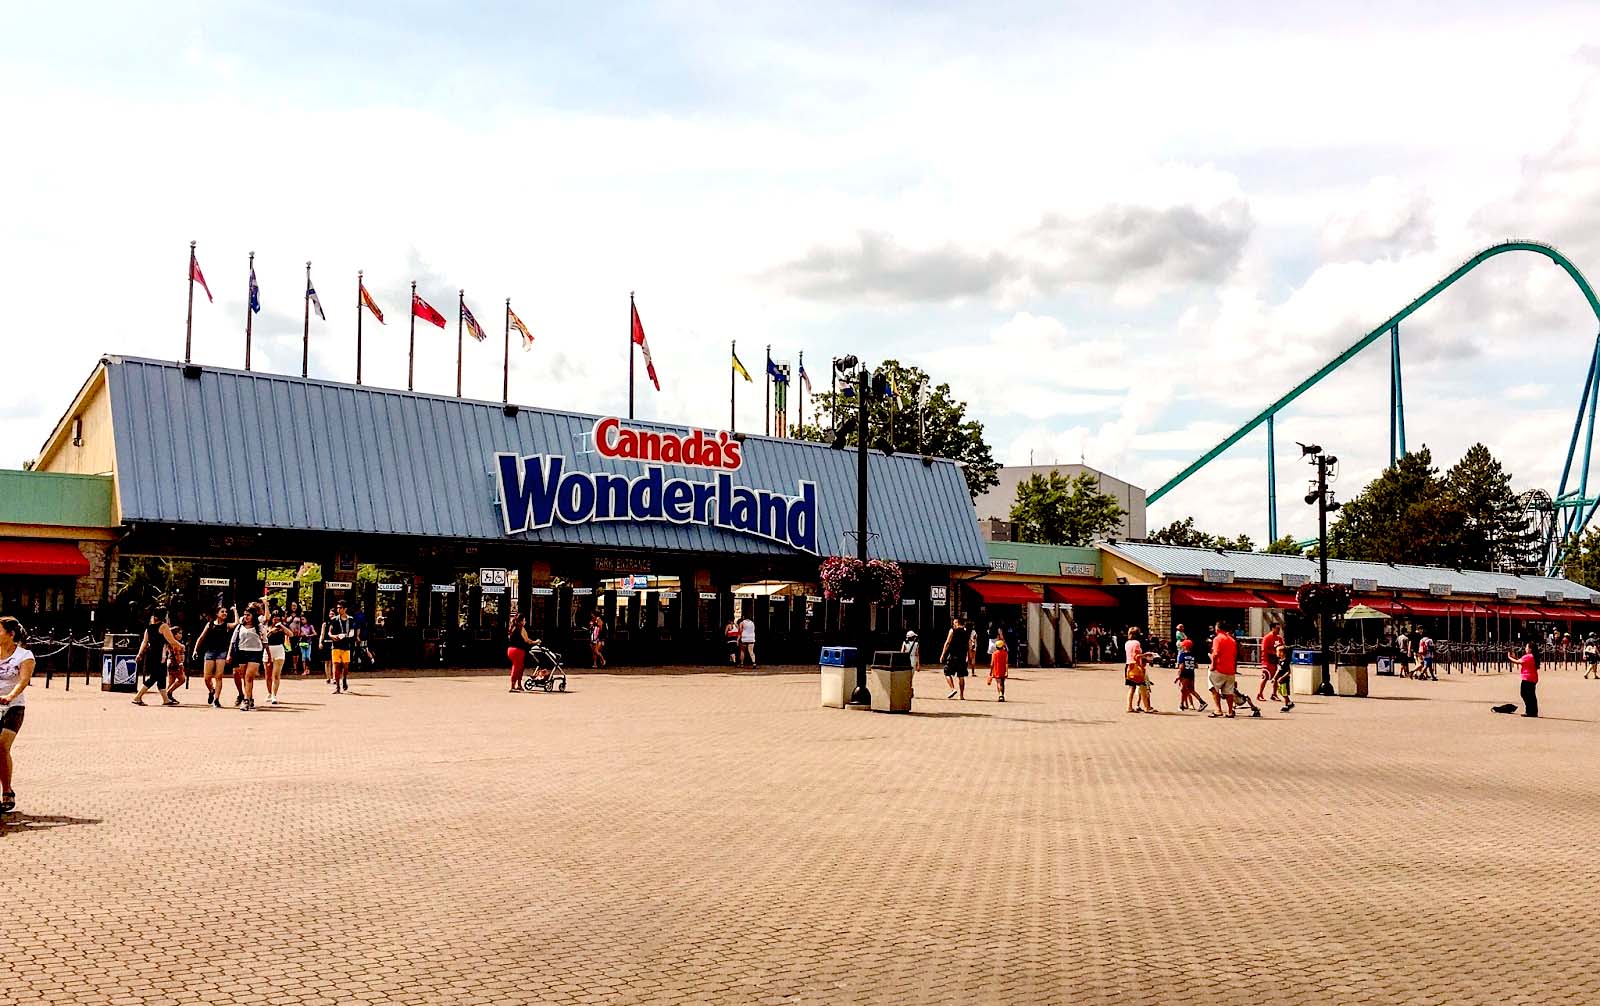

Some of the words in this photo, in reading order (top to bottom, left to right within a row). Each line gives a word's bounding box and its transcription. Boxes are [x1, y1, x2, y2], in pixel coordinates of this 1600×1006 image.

[594, 417, 742, 470] Canada's
[495, 453, 817, 555] Wonderland
[595, 557, 613, 569] PARK
[616, 558, 651, 570] ENTRANCE
